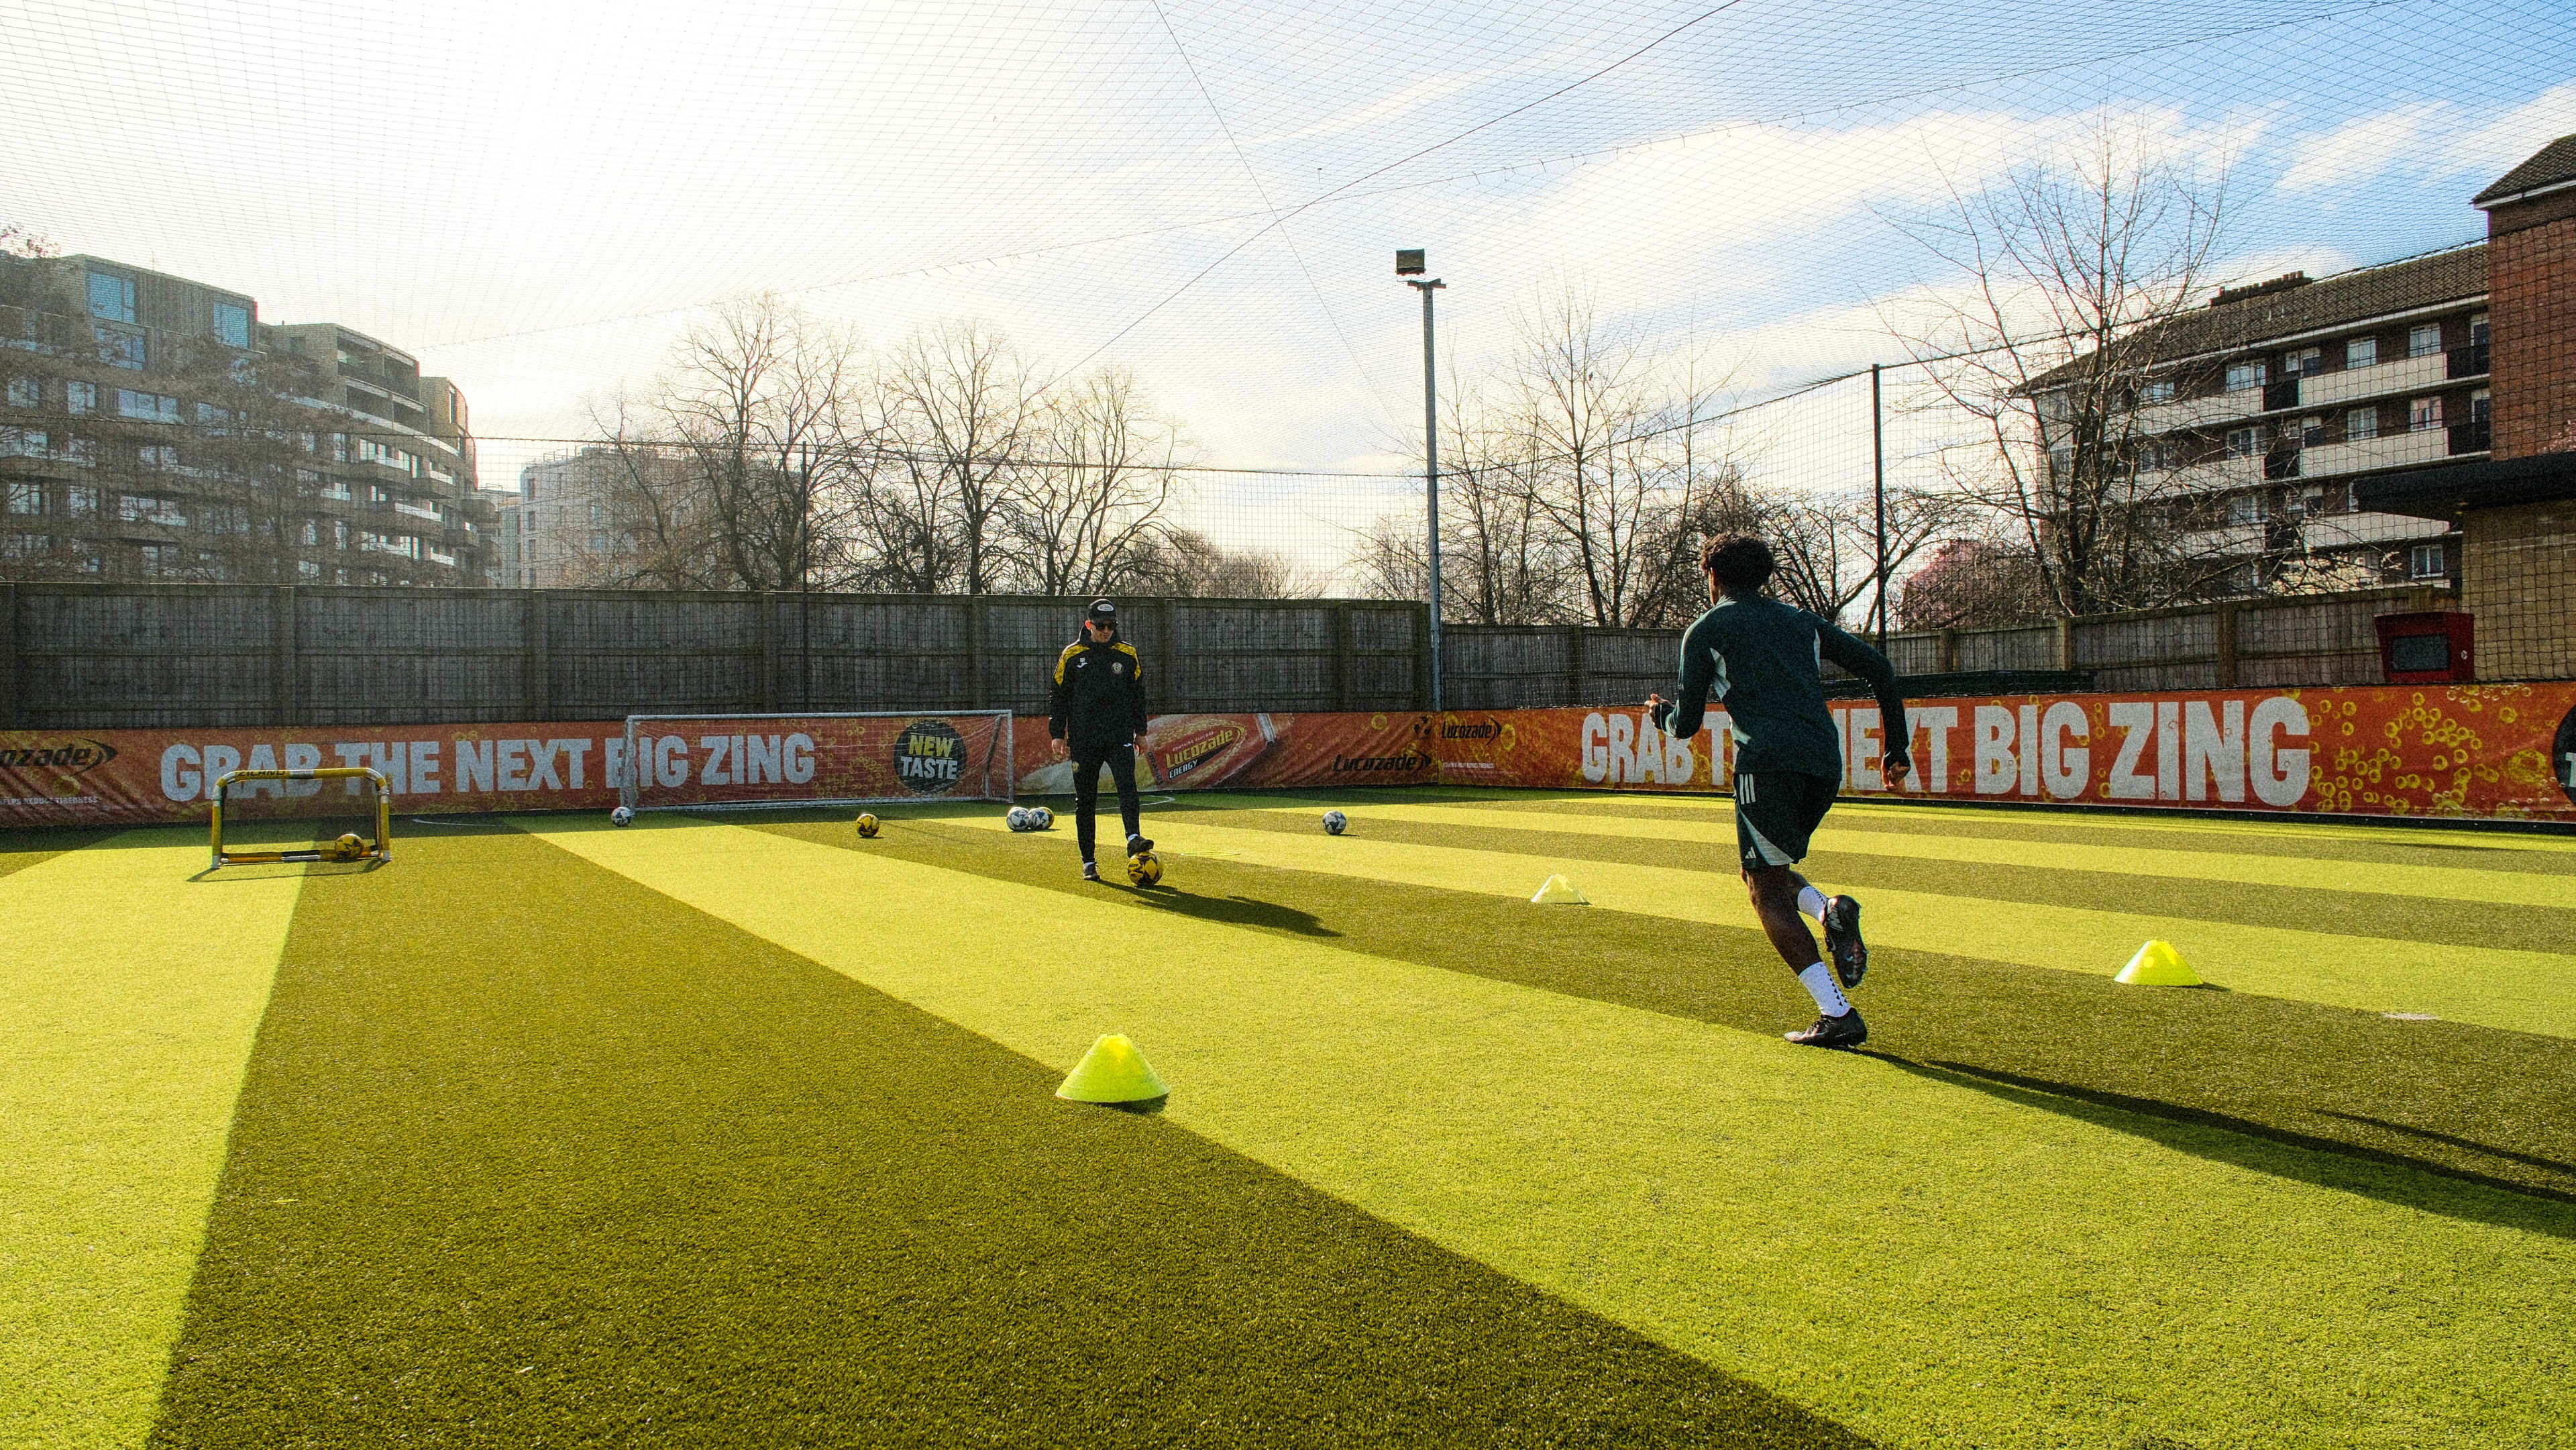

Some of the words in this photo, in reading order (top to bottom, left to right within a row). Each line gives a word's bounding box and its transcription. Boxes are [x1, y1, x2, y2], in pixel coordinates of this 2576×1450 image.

[1442, 721, 1493, 739] Lucozade
[908, 735, 954, 758] NEW
[1166, 729, 1234, 768] Lucozade
[1582, 712, 1694, 785] GRAB
[1975, 700, 2090, 800] BIG
[2109, 696, 2310, 807] ZING
[160, 743, 323, 802] GRAB
[335, 741, 440, 796] THE
[455, 738, 592, 792] NEXT
[606, 735, 688, 788] BIG
[701, 733, 815, 786] ZING
[900, 756, 958, 780] TASTE
[1169, 759, 1198, 779] ENERGY
[1333, 753, 1417, 772] Lucozade
